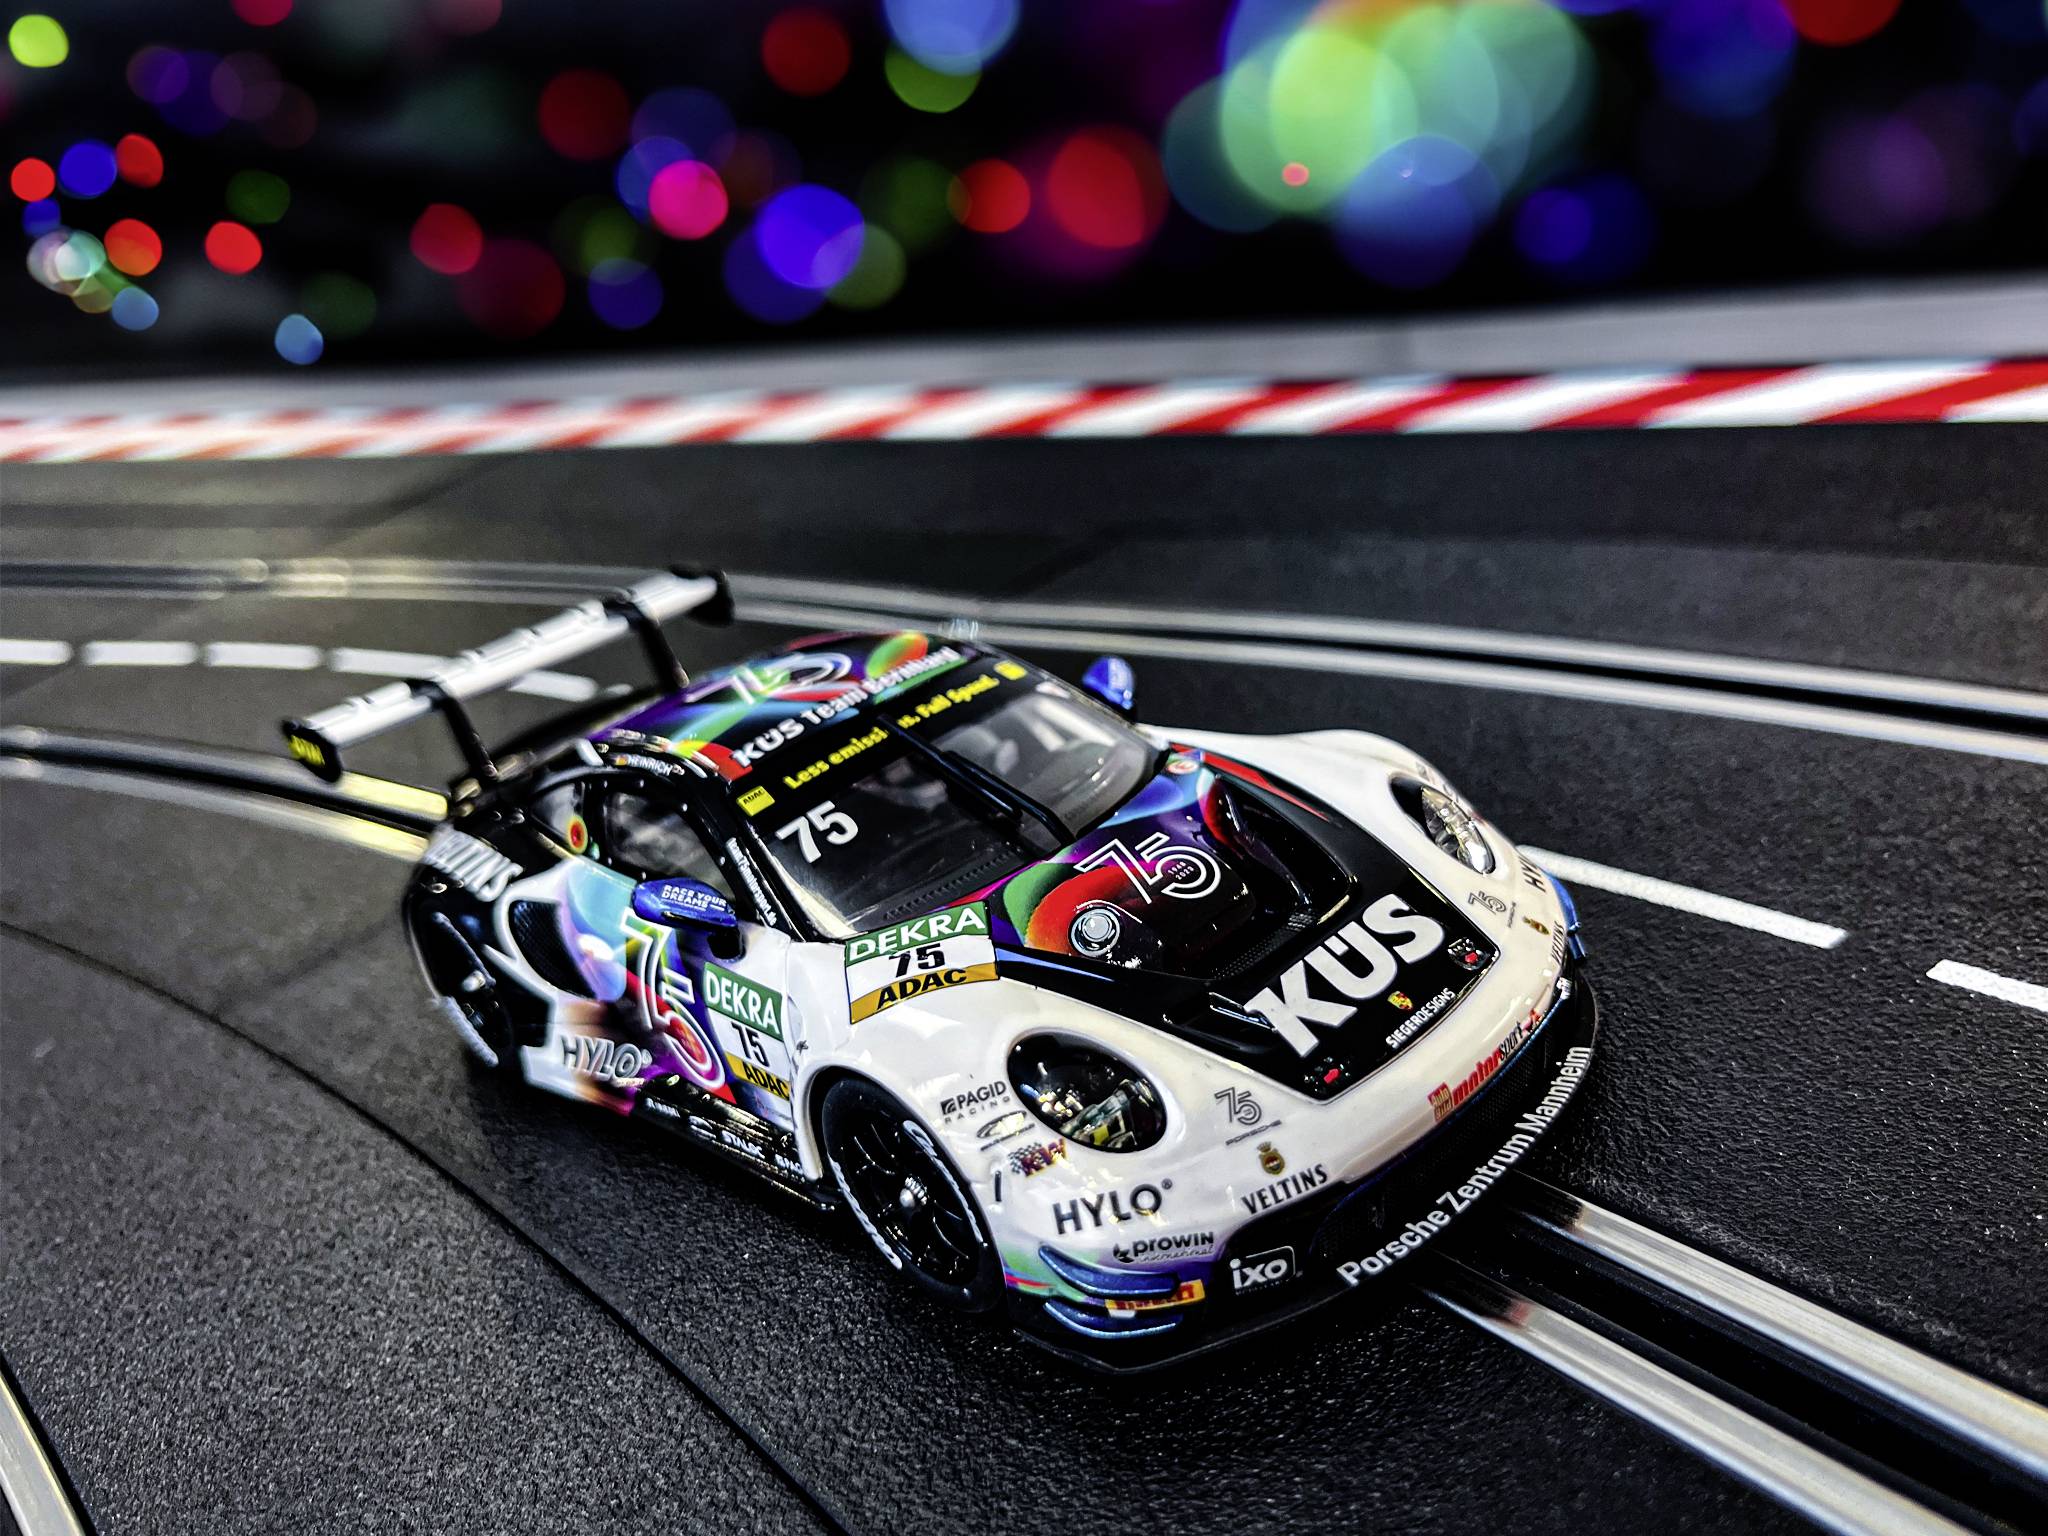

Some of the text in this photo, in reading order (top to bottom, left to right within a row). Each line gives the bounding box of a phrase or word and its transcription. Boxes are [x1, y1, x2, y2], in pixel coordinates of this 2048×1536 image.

[733, 714, 804, 767] KÜS
[801, 686, 868, 724] Team
[627, 754, 673, 776] HEINRICH
[784, 760, 829, 789] Less
[776, 800, 859, 863] 75
[1074, 831, 1222, 905] 75
[661, 891, 709, 908] DREAMS
[663, 884, 695, 898] RACE
[697, 891, 728, 907] YOUR
[848, 904, 986, 960] DEKRA
[888, 942, 946, 979] 75
[1243, 893, 1445, 1058] KÜS
[704, 969, 781, 1035] DEKRA
[877, 968, 967, 1011] ADAC
[1385, 987, 1457, 1050] SIEGERDESIGNS
[731, 1021, 770, 1068] 75
[743, 1063, 790, 1099] ADAC
[956, 1080, 1007, 1109] PAGID
[944, 1095, 1011, 1124] RACING
[1214, 1086, 1262, 1126] 75
[1336, 1046, 1594, 1286] Porsche Zentrum Mannheim
[1241, 1163, 1328, 1214] VELTINS
[1229, 1258, 1288, 1290] ixo
